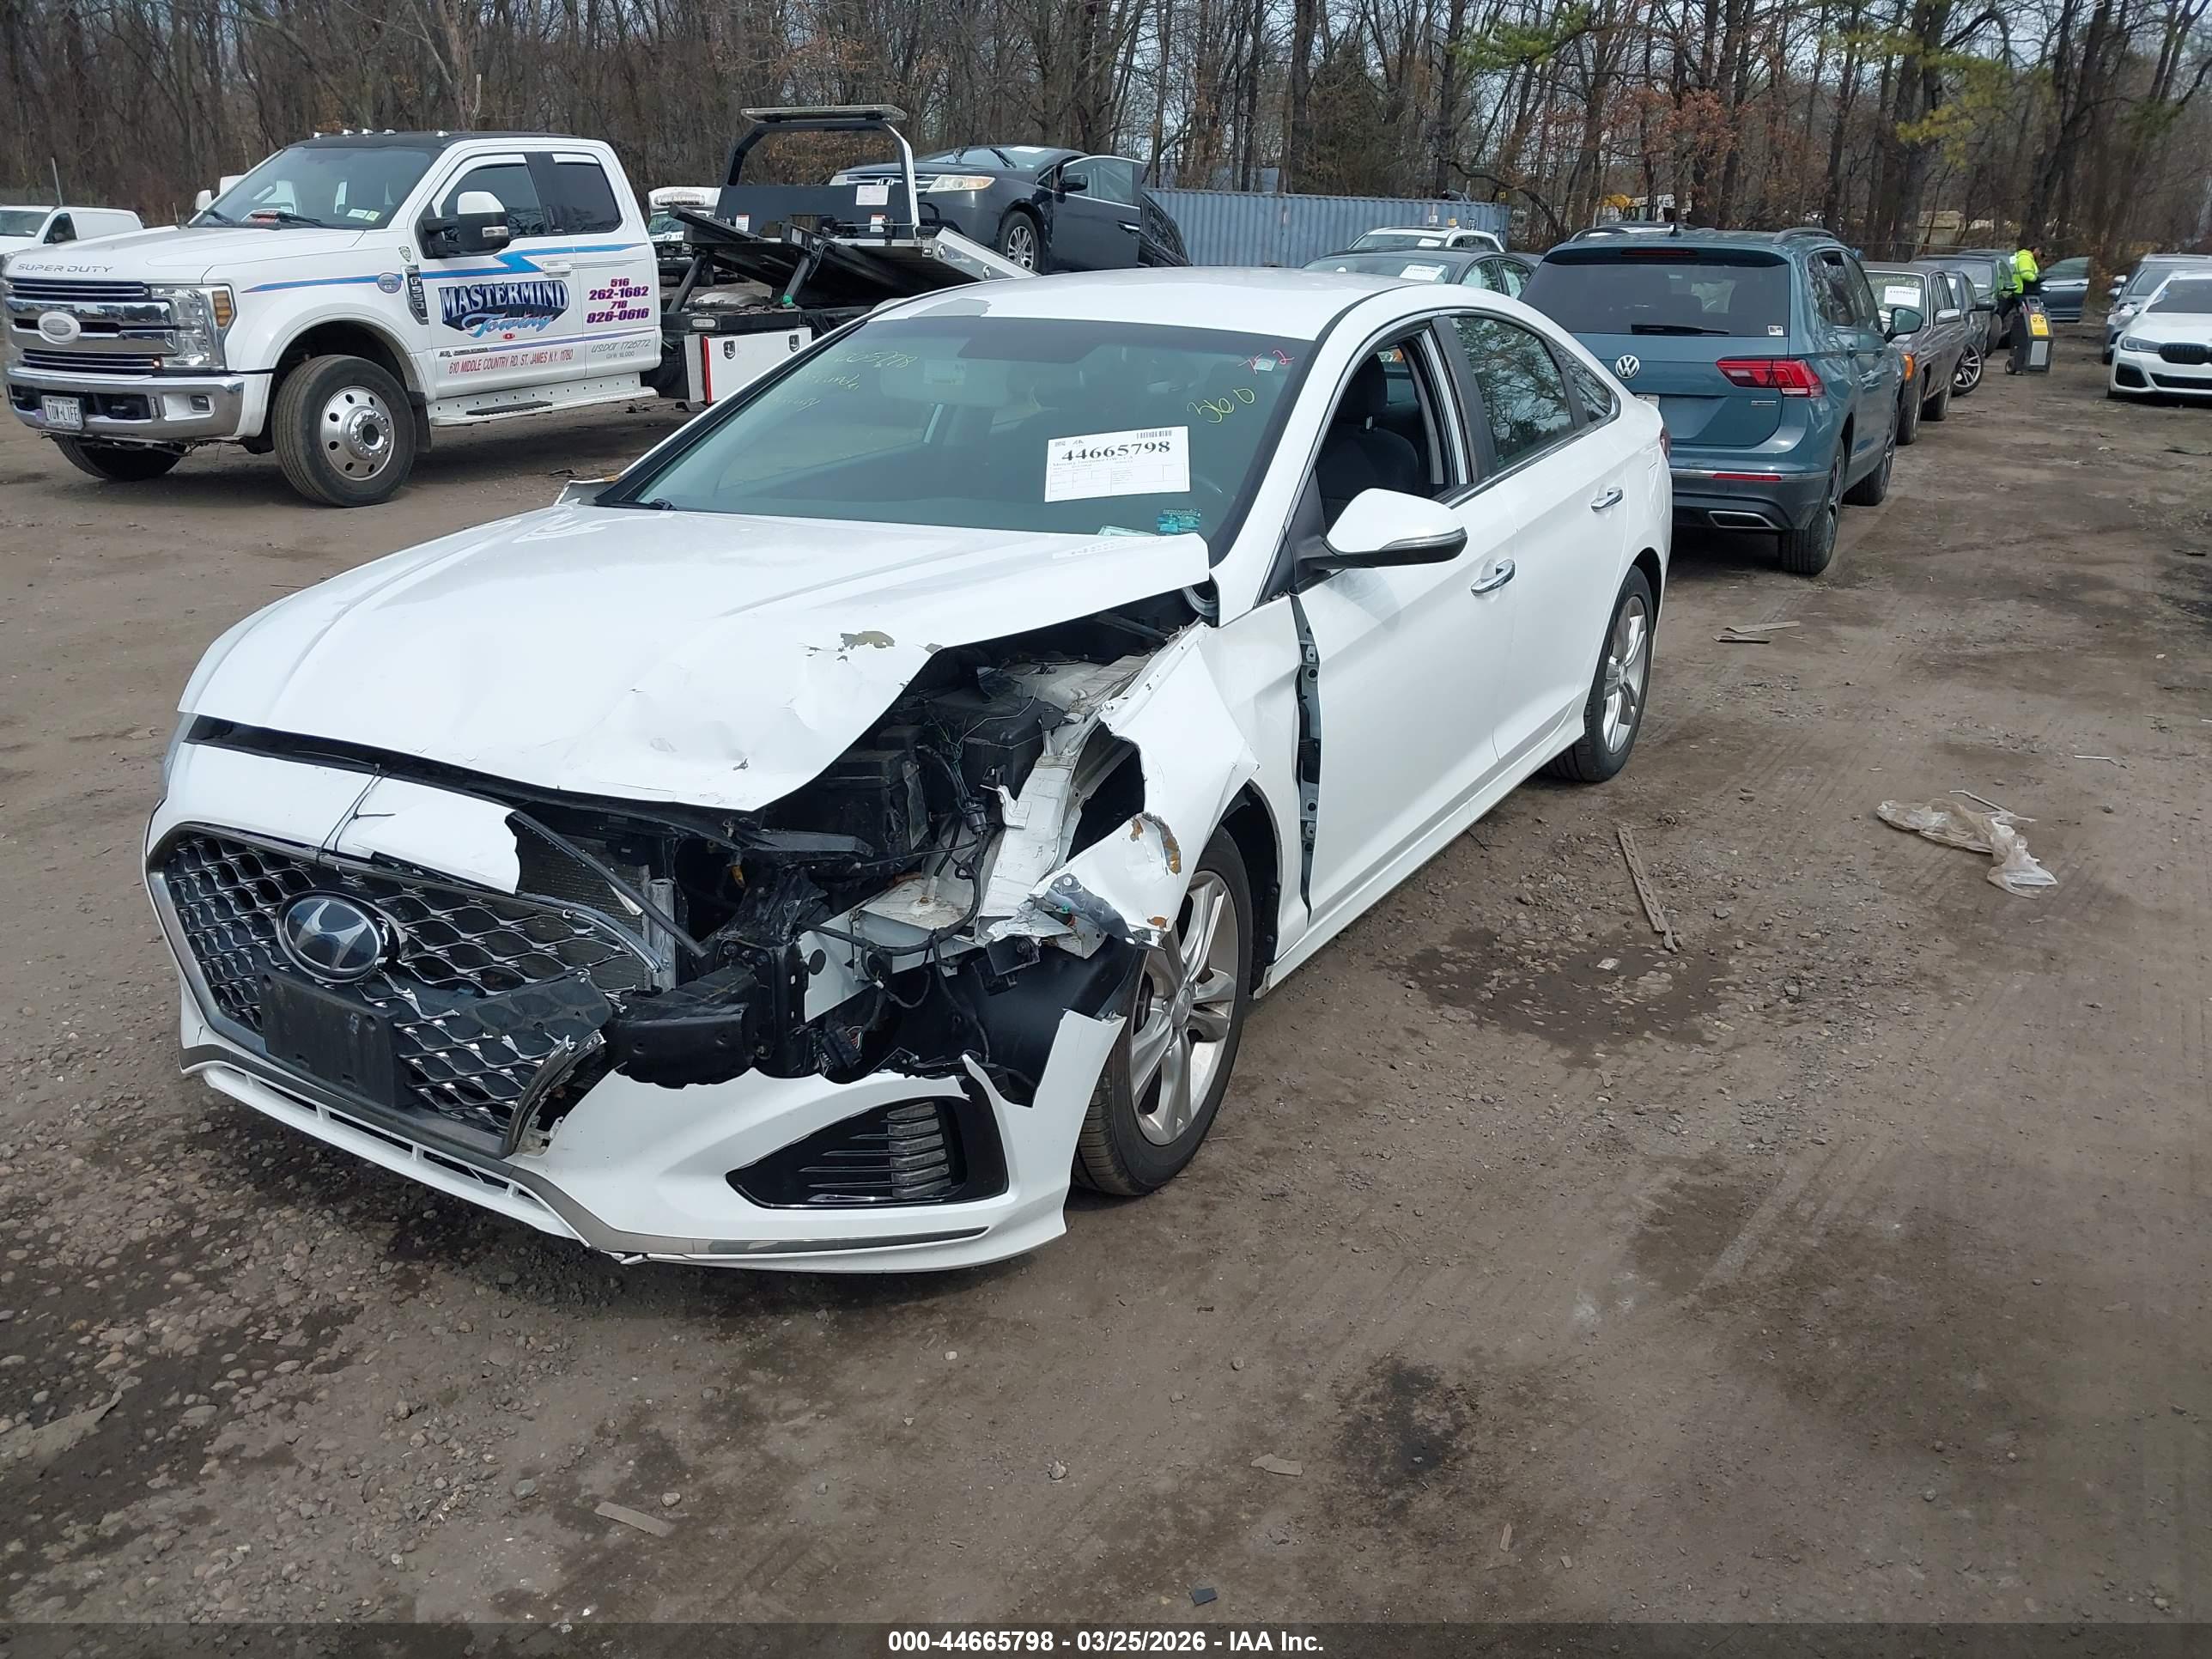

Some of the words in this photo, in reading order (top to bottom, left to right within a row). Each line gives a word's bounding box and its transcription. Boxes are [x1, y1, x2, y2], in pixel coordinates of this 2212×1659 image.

[17, 263, 64, 273] SUPER
[589, 286, 649, 301] 262-1682
[611, 278, 629, 288] 516
[439, 280, 569, 321] MASTERMIND
[461, 311, 555, 338] Towing
[460, 359, 482, 373] MIDDLE
[483, 356, 508, 370] COUNTRY
[530, 351, 548, 364] JAMES
[1061, 441, 1171, 462] 44665798
